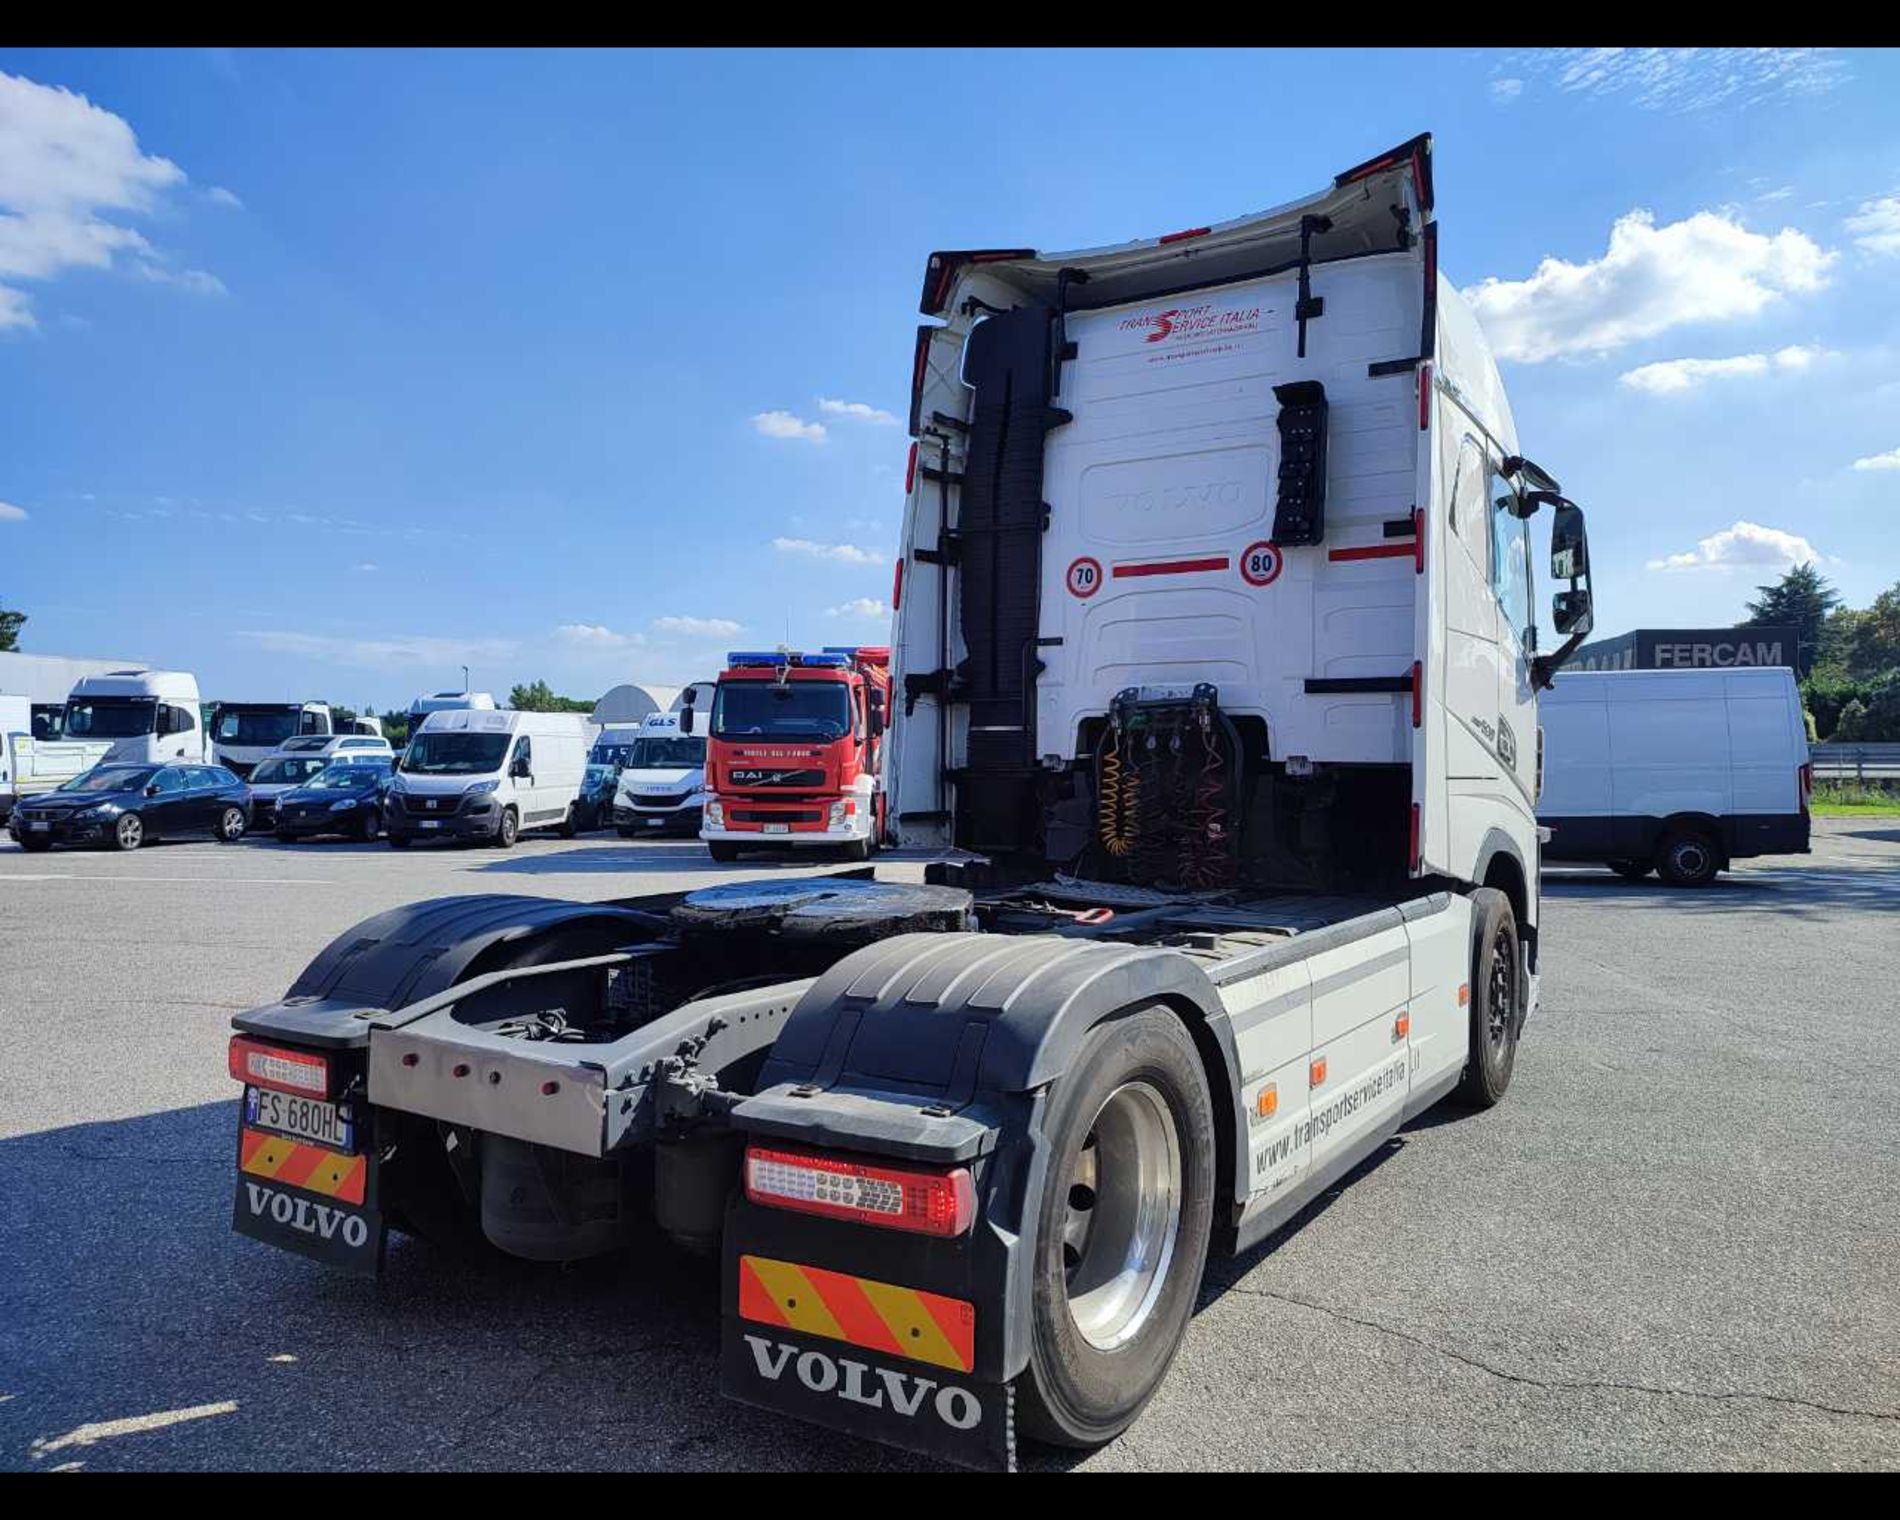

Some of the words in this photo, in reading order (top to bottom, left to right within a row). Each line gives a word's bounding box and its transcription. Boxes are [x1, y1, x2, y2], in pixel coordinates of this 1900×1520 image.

[1220, 308, 1260, 325] ITALIA
[1251, 554, 1272, 573] 80
[1076, 567, 1093, 585] 70
[1655, 642, 1783, 668] FERCAM
[649, 718, 677, 727] GLS
[259, 1091, 281, 1124] FS
[246, 1182, 368, 1248] VOLVO
[744, 1334, 982, 1430] VOLVO
